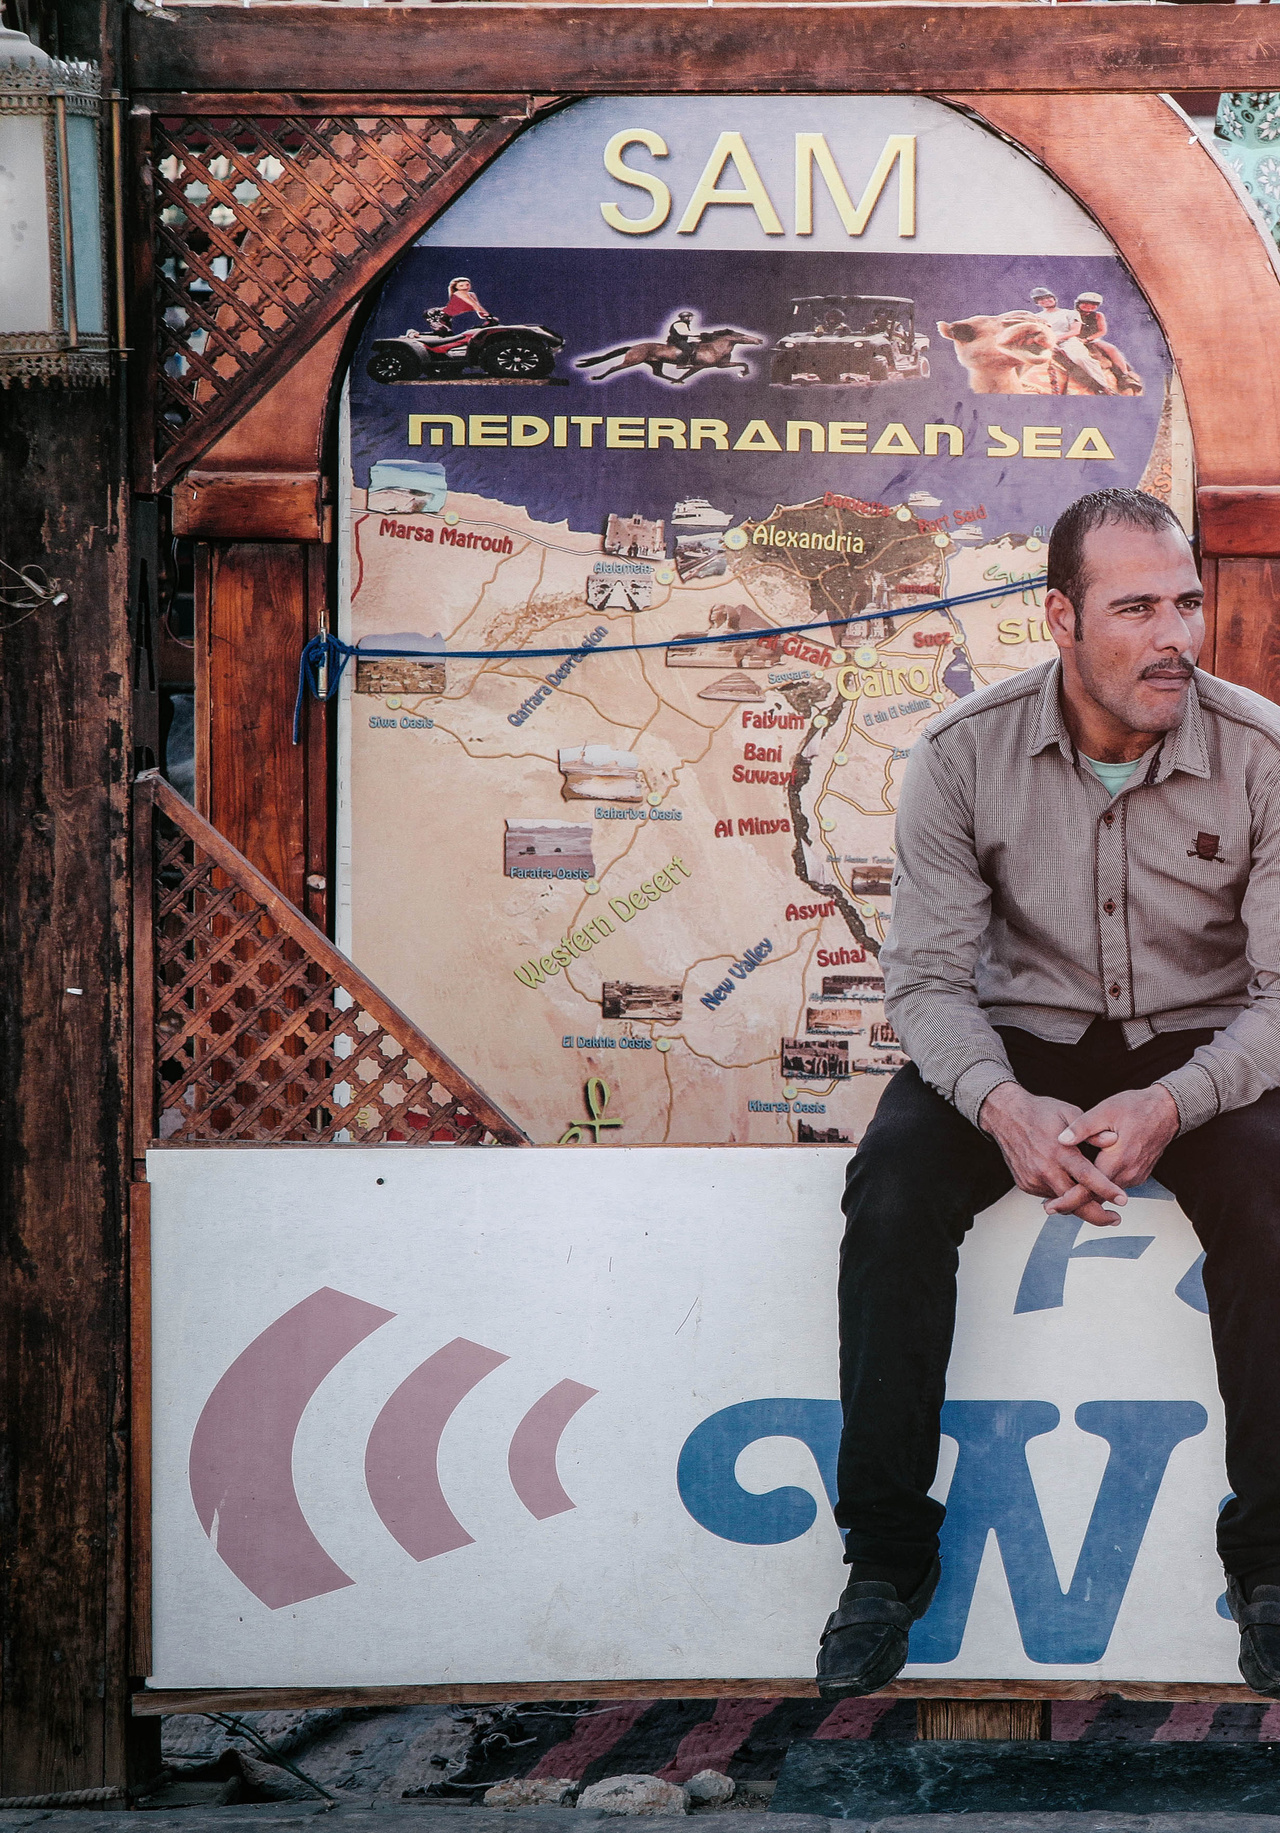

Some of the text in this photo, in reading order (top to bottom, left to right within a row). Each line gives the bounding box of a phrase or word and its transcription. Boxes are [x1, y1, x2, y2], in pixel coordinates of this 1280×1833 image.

[600, 128, 917, 239] SAM
[408, 414, 1115, 460] MEDITERRANEAN SEA
[823, 490, 891, 518] Damietta
[917, 503, 987, 534] Port Said
[379, 518, 514, 555] Marsa Matrouh
[752, 524, 864, 554] Alexandria
[783, 636, 833, 668] Gizah
[913, 631, 952, 649] Suez
[836, 661, 930, 701] Cairo
[507, 684, 553, 727] Qattara
[369, 716, 434, 729] Siwa Oasis
[742, 710, 805, 730] Faiyum
[744, 742, 783, 763] Bani
[732, 765, 798, 786] Suwayf
[595, 807, 683, 821] Bahariya Oasis
[714, 817, 791, 838] Al Minya
[510, 866, 590, 880] Farafra Oasis
[513, 855, 692, 990] Western Desert
[785, 901, 836, 921] Asyut
[816, 944, 867, 968] Suhaj
[701, 937, 773, 1012] New Valley
[562, 1035, 653, 1049] El Dakhla Oasis
[748, 1100, 827, 1114] Kharga Oasis
